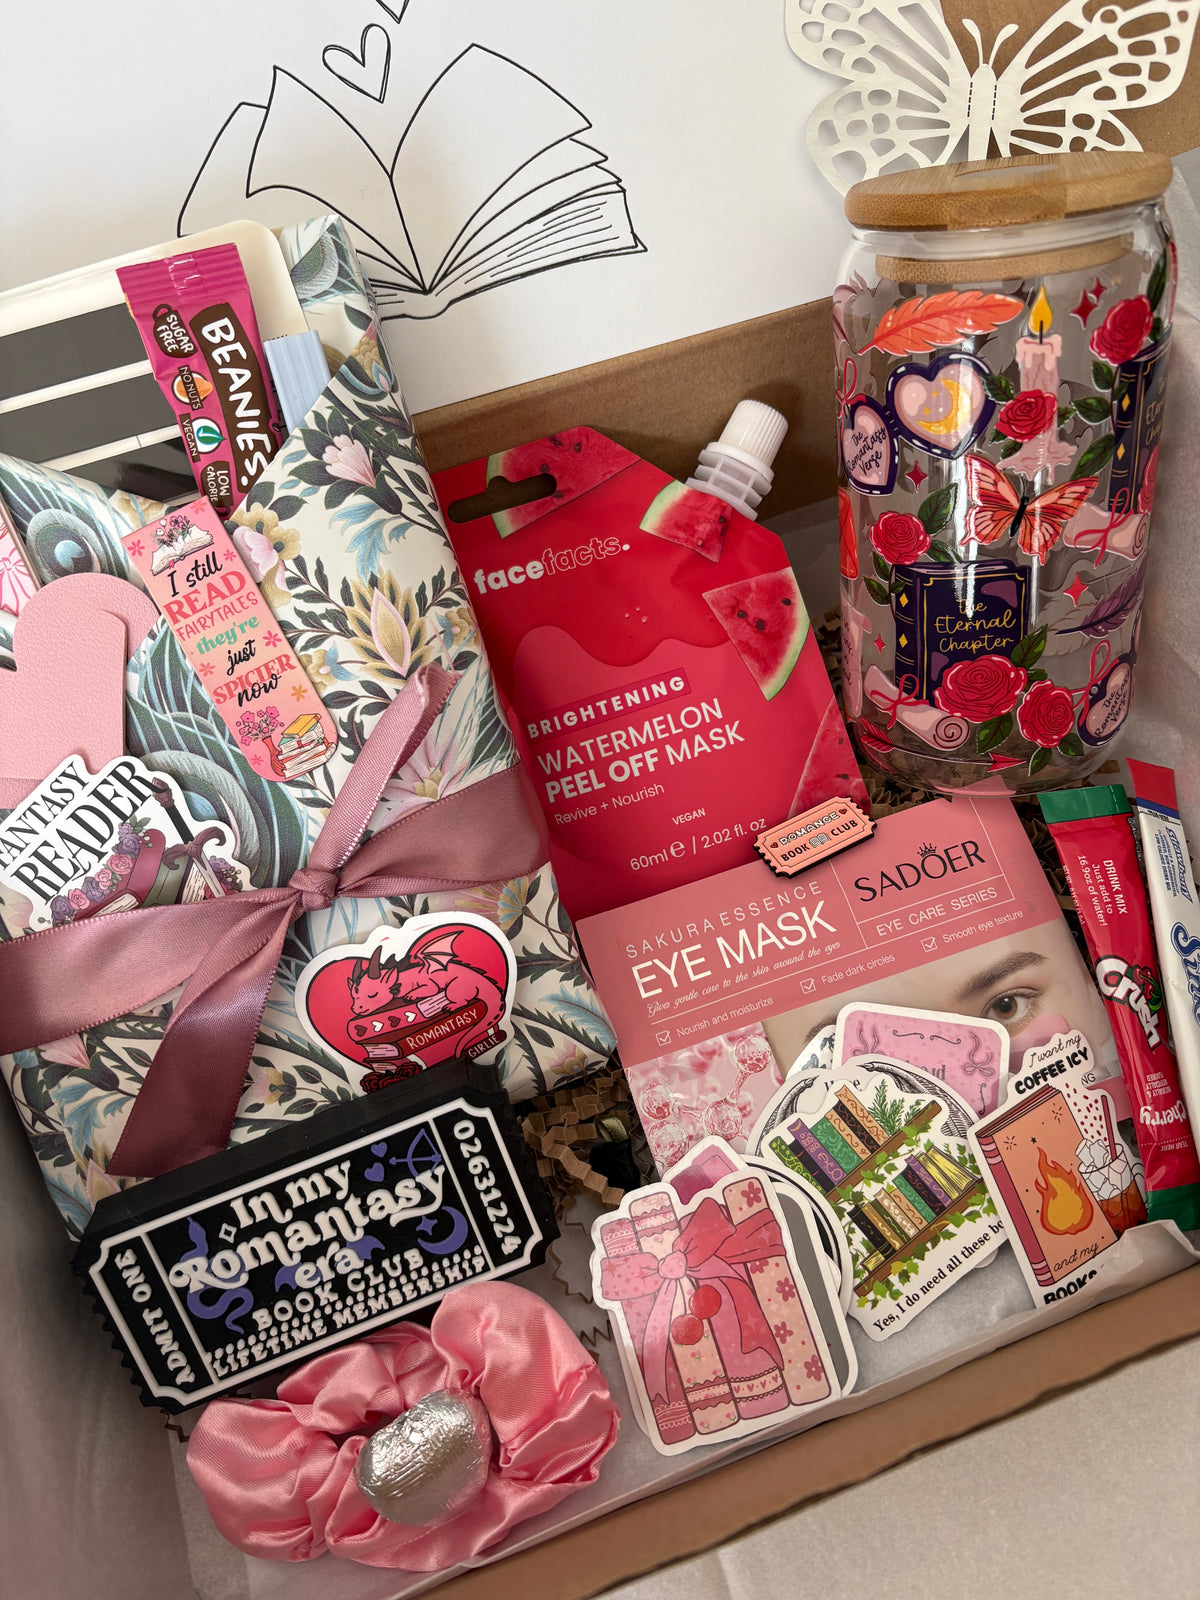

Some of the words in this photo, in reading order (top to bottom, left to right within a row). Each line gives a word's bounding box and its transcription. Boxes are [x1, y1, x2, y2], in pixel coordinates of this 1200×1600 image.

[156, 325, 180, 353] FREE
[166, 314, 194, 353] SUGAR
[180, 366, 192, 384] NO
[187, 384, 202, 410] NUTS
[201, 316, 272, 486] BEANIES.
[183, 418, 198, 457] VEGAN
[846, 427, 887, 472] Romantasy
[206, 465, 219, 502] CALORIE
[216, 470, 230, 496] LOW
[859, 450, 882, 476] Verse
[167, 569, 182, 598] I
[185, 551, 223, 588] still
[163, 570, 247, 626] READ
[175, 591, 259, 642] FAIRYTALES
[955, 598, 987, 615] te
[195, 616, 260, 655] they're
[934, 608, 1017, 635] Eternal
[226, 639, 256, 676] just
[939, 633, 1015, 655] Chapter
[212, 653, 298, 705] SPICIER
[237, 673, 282, 707] now
[526, 675, 686, 740] BRIGHTENING
[536, 697, 724, 777] WATERMELON
[545, 767, 606, 803] PEEL
[607, 748, 659, 784] OFF
[666, 720, 745, 767] MASK
[0, 761, 90, 870] ANTASY
[554, 803, 598, 826] Revive
[610, 781, 665, 810] Nourish
[671, 807, 706, 825] VEGAN
[10, 760, 170, 905] READER
[701, 826, 731, 851] 2.02
[734, 821, 749, 842] fl.
[750, 817, 767, 835] oz
[778, 811, 841, 846] ROMANCE
[780, 843, 811, 862] BOOK
[830, 819, 858, 837] CLUB
[853, 839, 986, 902] SADOER
[1077, 855, 1093, 885] 16.9oz
[1087, 885, 1098, 895] of
[1091, 863, 1105, 883] Just
[1103, 859, 1122, 892] DRINK
[1114, 894, 1128, 915] MIX
[875, 918, 905, 937] EYE
[908, 904, 946, 925] CARE
[950, 887, 998, 911] SERIES
[1092, 897, 1108, 926] water!
[1099, 884, 1112, 903] add
[1105, 904, 1113, 914] to
[625, 918, 715, 959] SAKURA
[719, 881, 822, 928] ESSENCE
[942, 925, 977, 944] Smooth
[978, 920, 994, 933] eye
[994, 910, 1024, 926] texture
[631, 943, 713, 1000] EYE
[715, 900, 837, 969] MASK
[821, 966, 845, 985] Fade
[845, 960, 866, 978] dark
[867, 953, 896, 971] circles
[647, 1001, 671, 1018] Gives
[673, 990, 699, 1010] gentle
[702, 983, 720, 996] care
[722, 977, 732, 988] to
[735, 970, 750, 984] the
[751, 964, 769, 979] skin
[773, 952, 805, 970] around
[807, 947, 822, 959] the
[824, 941, 841, 955] eyes
[676, 1018, 711, 1038] Nourish
[712, 1012, 729, 1027] and
[730, 997, 774, 1018] moisturize
[1095, 957, 1162, 1051] Crush
[406, 1008, 478, 1050] ROMANTASY
[467, 1034, 501, 1059] GIRLIE
[1037, 1037, 1064, 1062] want
[1065, 1034, 1082, 1049] my
[1014, 1059, 1067, 1095] COFFEE
[1066, 1046, 1088, 1069] ICY
[1140, 1100, 1187, 1126] Cherry
[228, 1188, 293, 1230] In
[285, 1160, 352, 1211] my
[453, 1119, 523, 1256] 02631224
[168, 1164, 446, 1295] Romantasy
[294, 1241, 364, 1290] era
[1053, 1248, 1078, 1272] and
[1079, 1242, 1099, 1259] my
[252, 1281, 339, 1332] BOOK
[347, 1248, 424, 1293] CLUB
[873, 1313, 901, 1333] Yes,
[895, 1302, 907, 1314] I
[905, 1292, 921, 1307] do
[919, 1268, 947, 1295] need
[946, 1255, 963, 1273] all
[960, 1232, 991, 1259] these
[213, 1320, 328, 1378] LIFETIME
[332, 1254, 487, 1329] MEMBERSHIP
[142, 1306, 197, 1387] ADMIT
